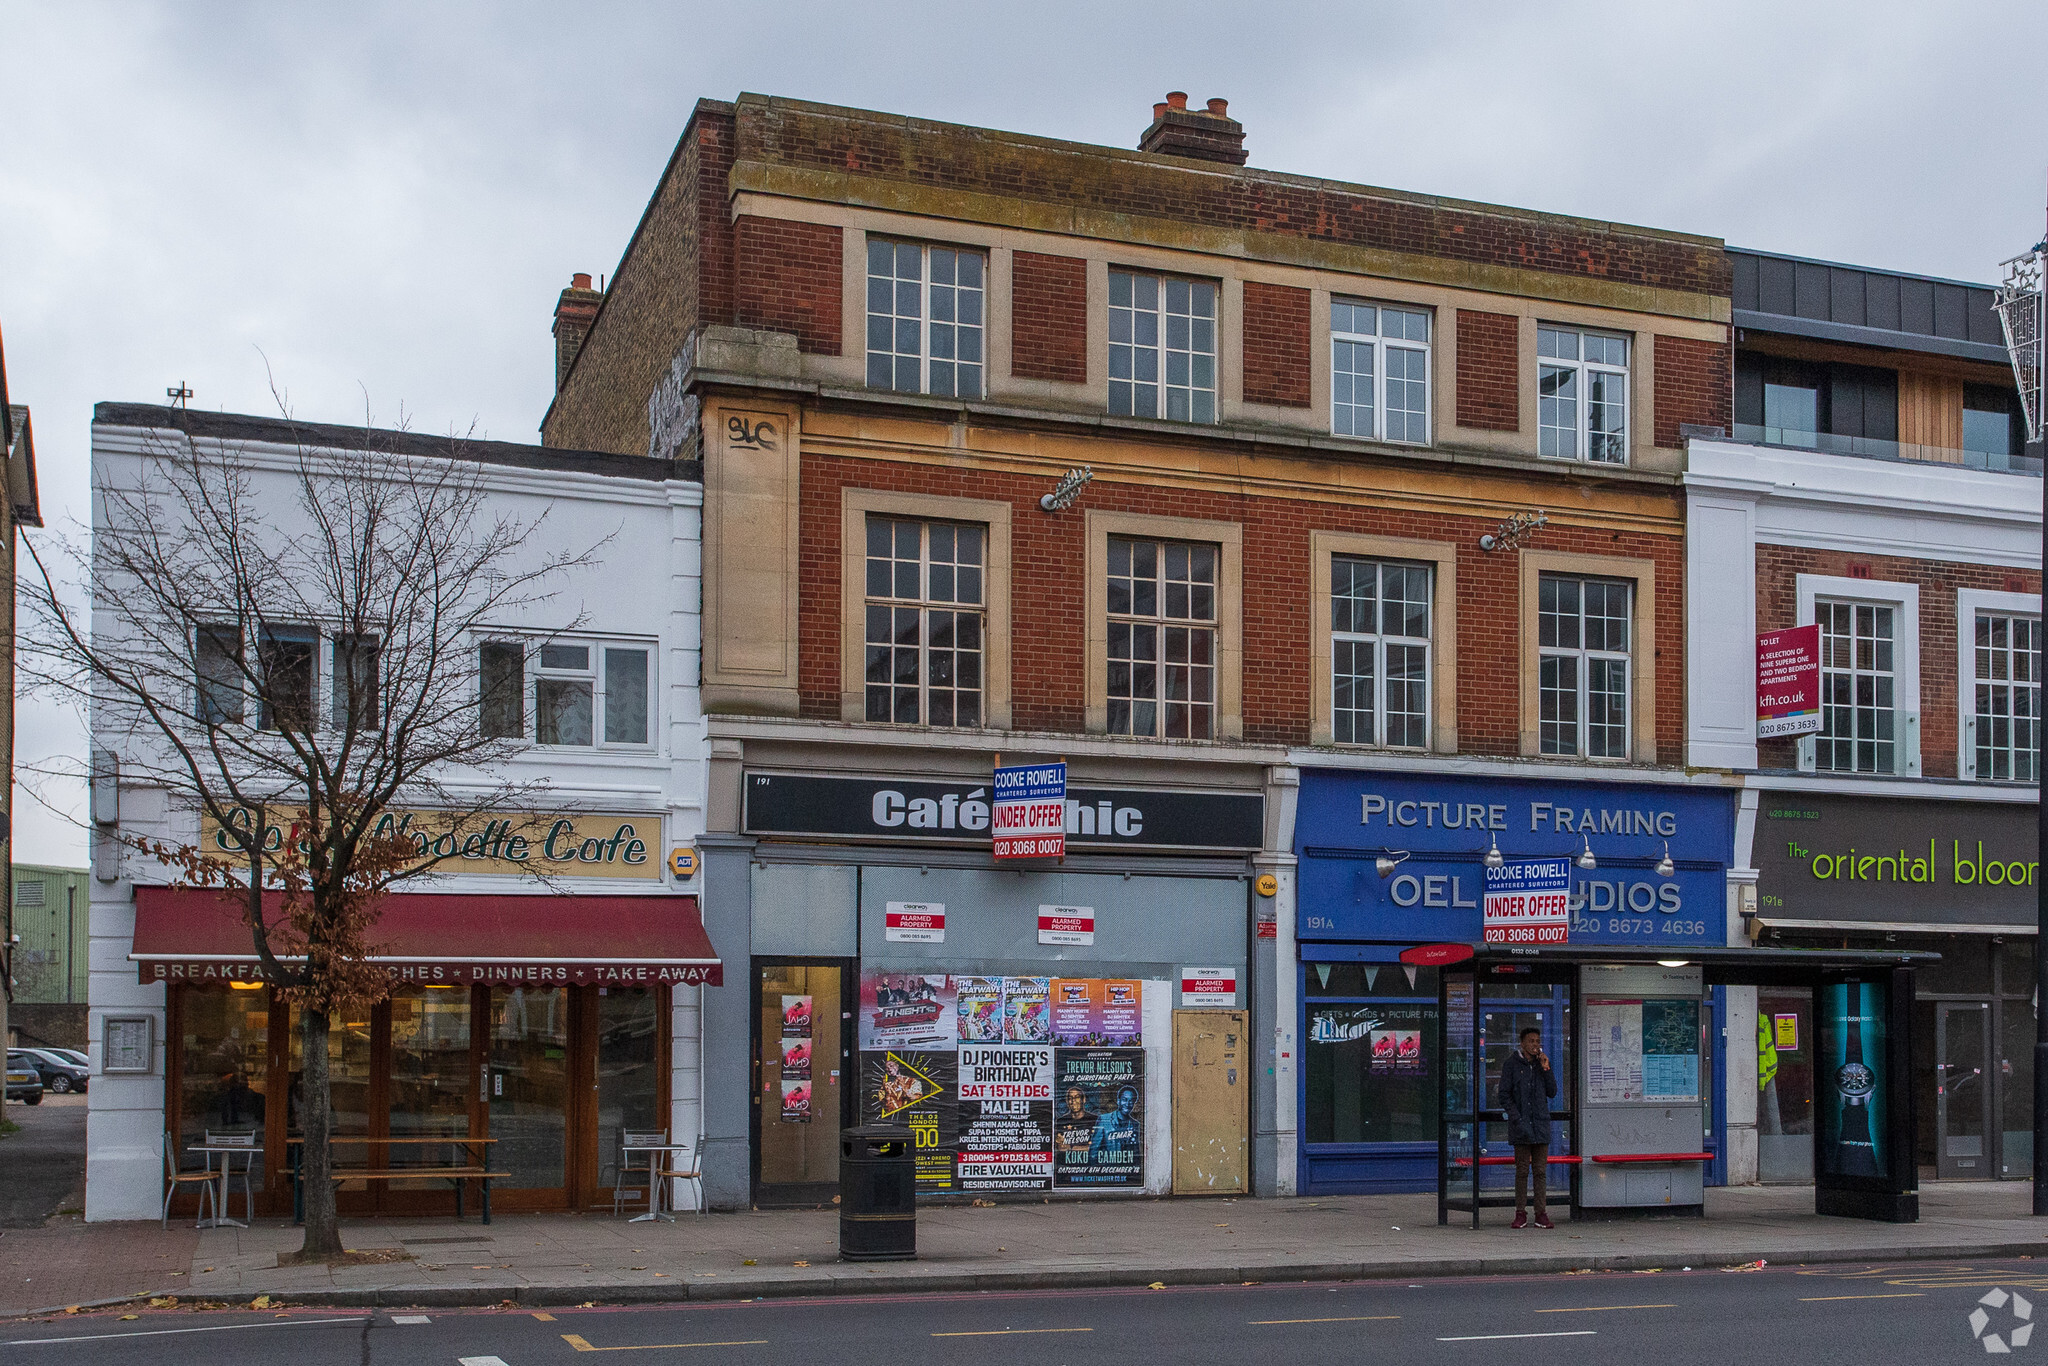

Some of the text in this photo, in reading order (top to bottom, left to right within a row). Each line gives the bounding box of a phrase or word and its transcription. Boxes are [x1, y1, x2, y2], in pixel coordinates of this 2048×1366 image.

[1769, 637, 1780, 645] LET
[1765, 649, 1796, 659] SELECTION
[1796, 647, 1804, 655] OF
[1775, 657, 1796, 666] SUPERB
[1797, 655, 1809, 663] ONE
[1760, 662, 1817, 677] AND TWO BEDROOM
[1760, 674, 1797, 685] APARTMENTS
[1760, 690, 1805, 707] kfh.co.uk
[1760, 719, 1817, 734] 020 8675 3639
[756, 777, 771, 786] 191
[995, 768, 1064, 789] COOKE ROWELL
[996, 787, 1062, 798] CHARTERED SURVEYORS
[872, 787, 1143, 837] Café hic
[994, 804, 1062, 828] UNDER OFFER
[1361, 794, 1677, 837] PICTURE FRAMING
[1784, 810, 1801, 819] 8675
[1803, 811, 1819, 819] 1523
[543, 818, 648, 865] Cafe
[994, 839, 1062, 856] 020 3068 0007
[677, 858, 692, 866] ADT
[1787, 842, 1808, 858] The
[1812, 838, 1935, 882] oriental
[1486, 863, 1567, 880] COOKE ROWELL
[1569, 880, 1682, 913] UDIOS
[1762, 895, 1783, 906] 191B
[1486, 895, 1566, 918] UNDER OFFER
[1307, 916, 1334, 929] 191A
[1608, 918, 1653, 934] 8673
[1661, 920, 1705, 935] 4636
[1486, 927, 1565, 942] 020 3068 0007
[154, 964, 307, 978] BREAKFA
[472, 967, 568, 980] DINNERS
[594, 967, 711, 980] TAKE-AWAY
[894, 1006, 927, 1017] NIGHT
[1351, 1010, 1378, 1019] CARDS
[1389, 1010, 1421, 1019] PICTURE
[963, 1050, 1049, 1066] DJ PIONEER'S
[1066, 1061, 1132, 1074] TREVOR NELSON'S
[974, 1067, 1038, 1082] BIRTHDAY
[961, 1085, 1050, 1097] SAT 15TH DEC
[981, 1101, 1030, 1114] MALEH
[1063, 1129, 1090, 1138] TREVOR
[1108, 1131, 1133, 1140] LEMAR
[1063, 1136, 1090, 1145] NELSON
[1065, 1150, 1134, 1164] KOKO CAMDEN
[962, 1165, 1047, 1175] FIRE VAUXHALL
[1058, 1166, 1088, 1174] SATURDAY
[963, 1180, 1046, 1189] RESIDENTADVISOR.NET
